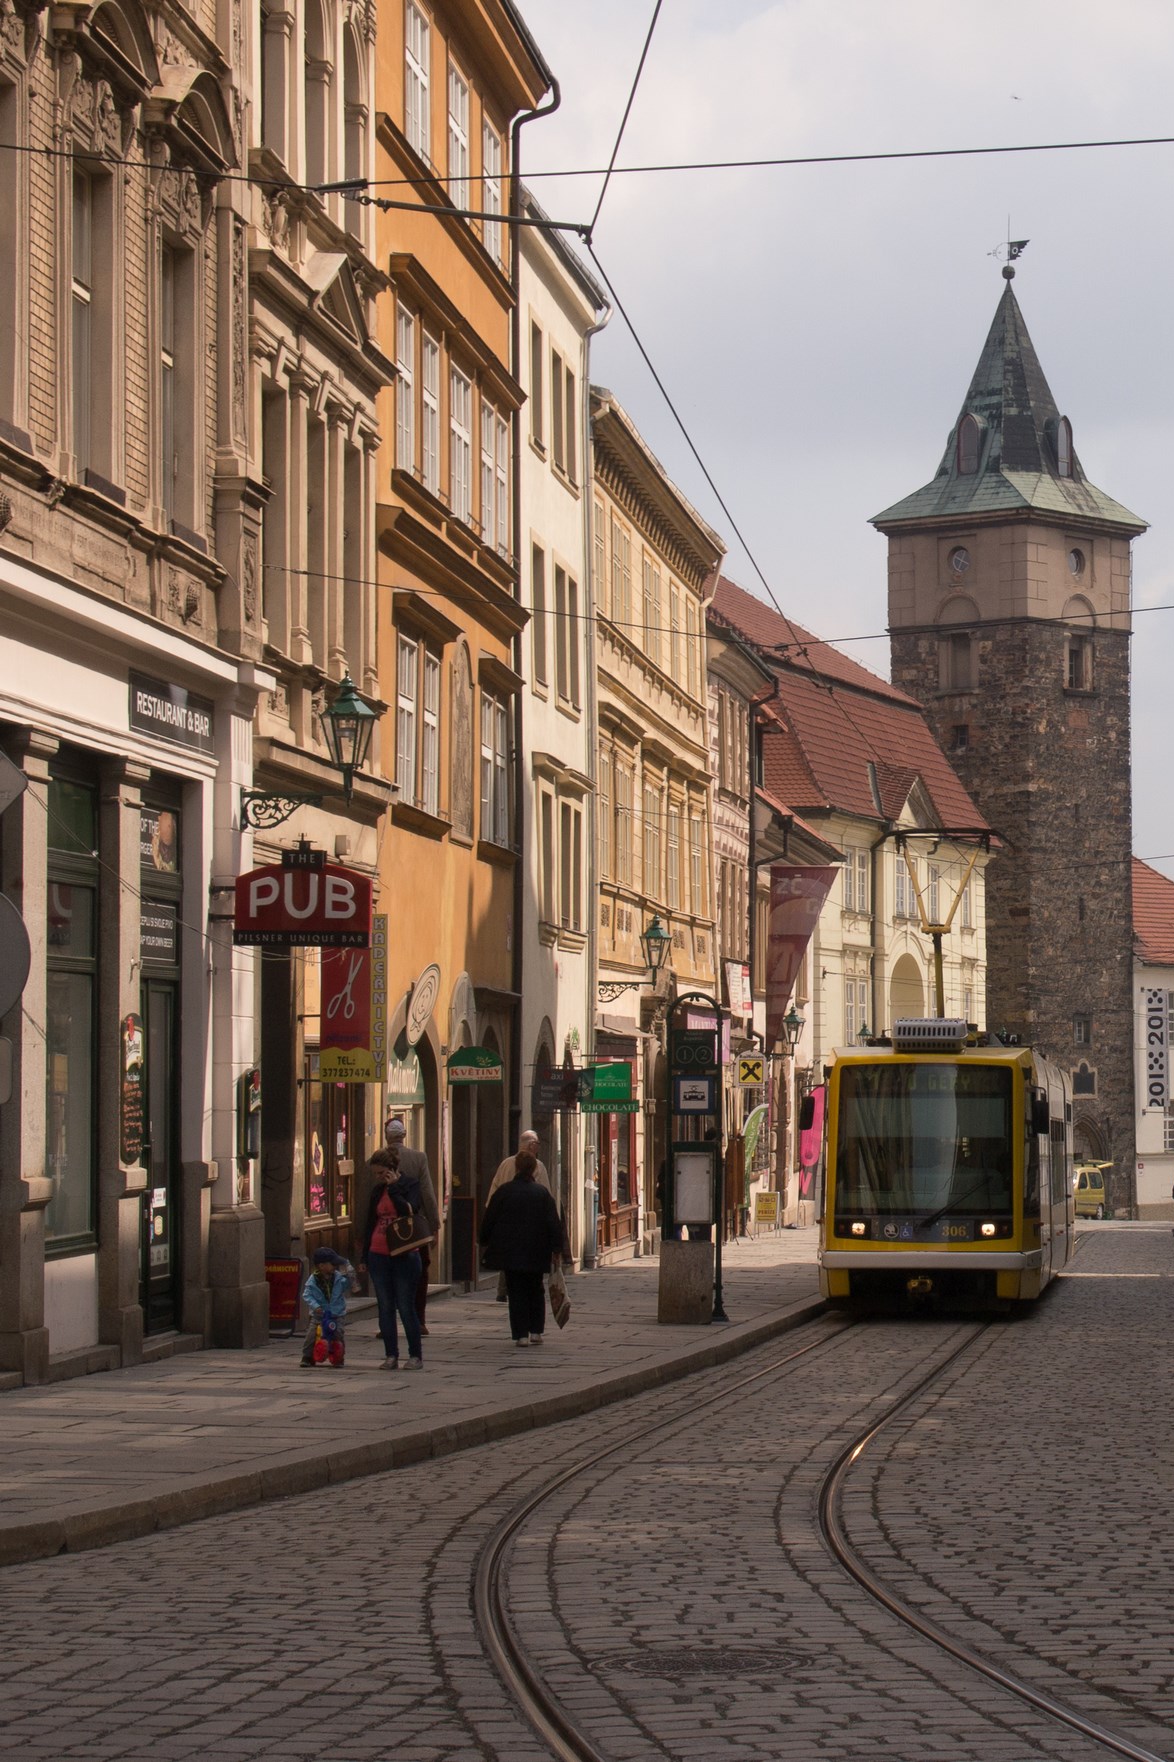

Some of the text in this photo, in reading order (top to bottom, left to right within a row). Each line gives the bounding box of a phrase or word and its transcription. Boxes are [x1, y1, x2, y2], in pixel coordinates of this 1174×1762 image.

[137, 691, 210, 737] RESTAURANT & BAR
[289, 853, 316, 864] THE
[249, 872, 357, 919] PUB
[238, 933, 363, 943] PILSNER UNIQUE BAR
[373, 917, 385, 1079] KADEŘNICTVÍ
[337, 1056, 356, 1066] TEL.:
[322, 1068, 370, 1078] 377237474
[450, 1067, 501, 1076] KVĚTINY
[582, 1103, 639, 1112] CHOCOLATE
[942, 1225, 967, 1237] 306
